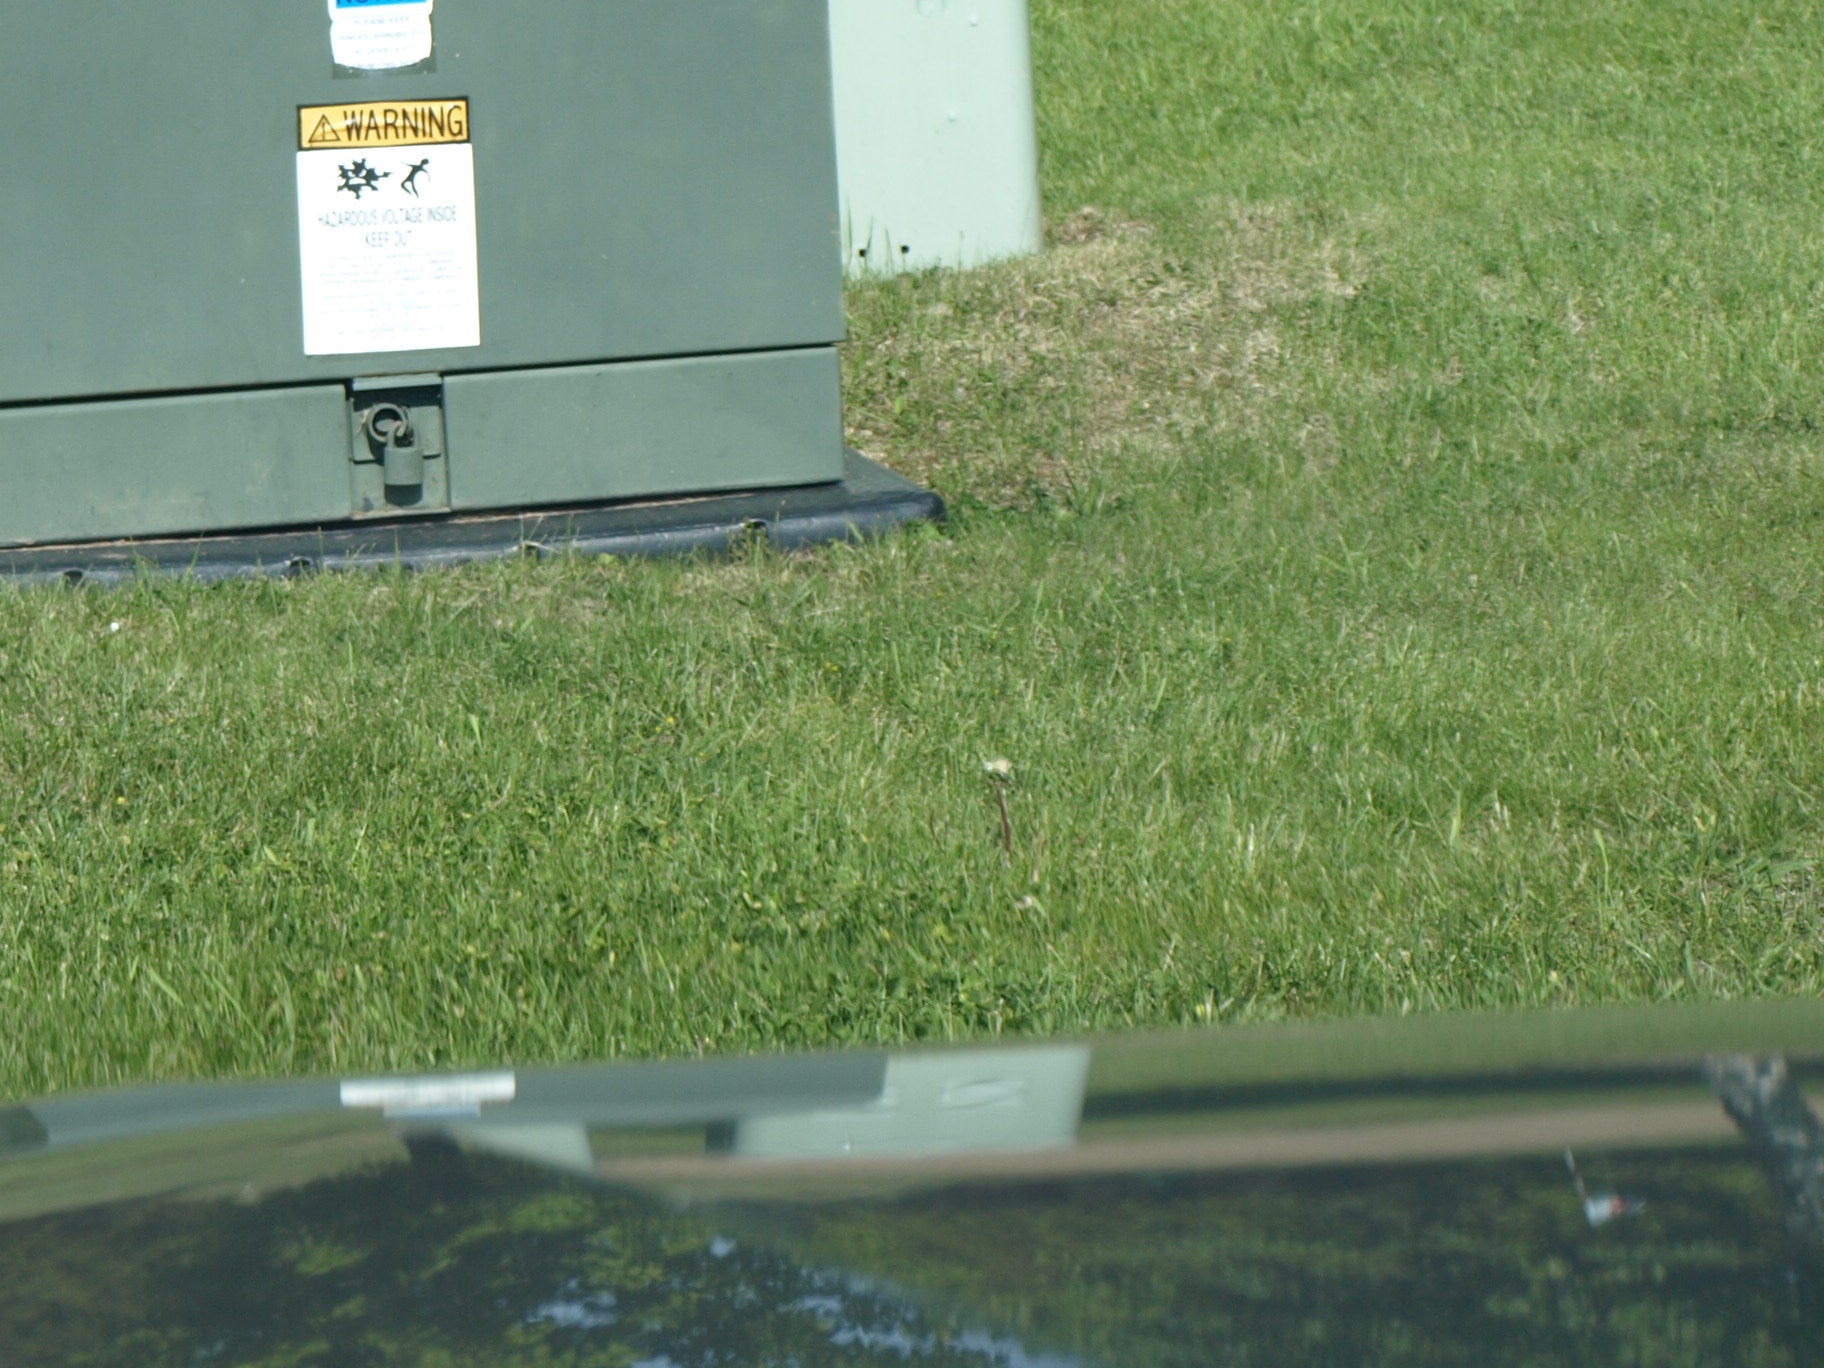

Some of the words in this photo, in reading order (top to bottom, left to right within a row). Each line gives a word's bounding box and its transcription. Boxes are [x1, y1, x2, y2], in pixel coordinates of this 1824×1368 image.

[343, 105, 464, 142] WARNING
[318, 209, 377, 227] HAZARDOUS
[382, 207, 423, 224] VOLTAGE
[427, 205, 457, 222] INSIDE
[366, 231, 389, 247] KEEP
